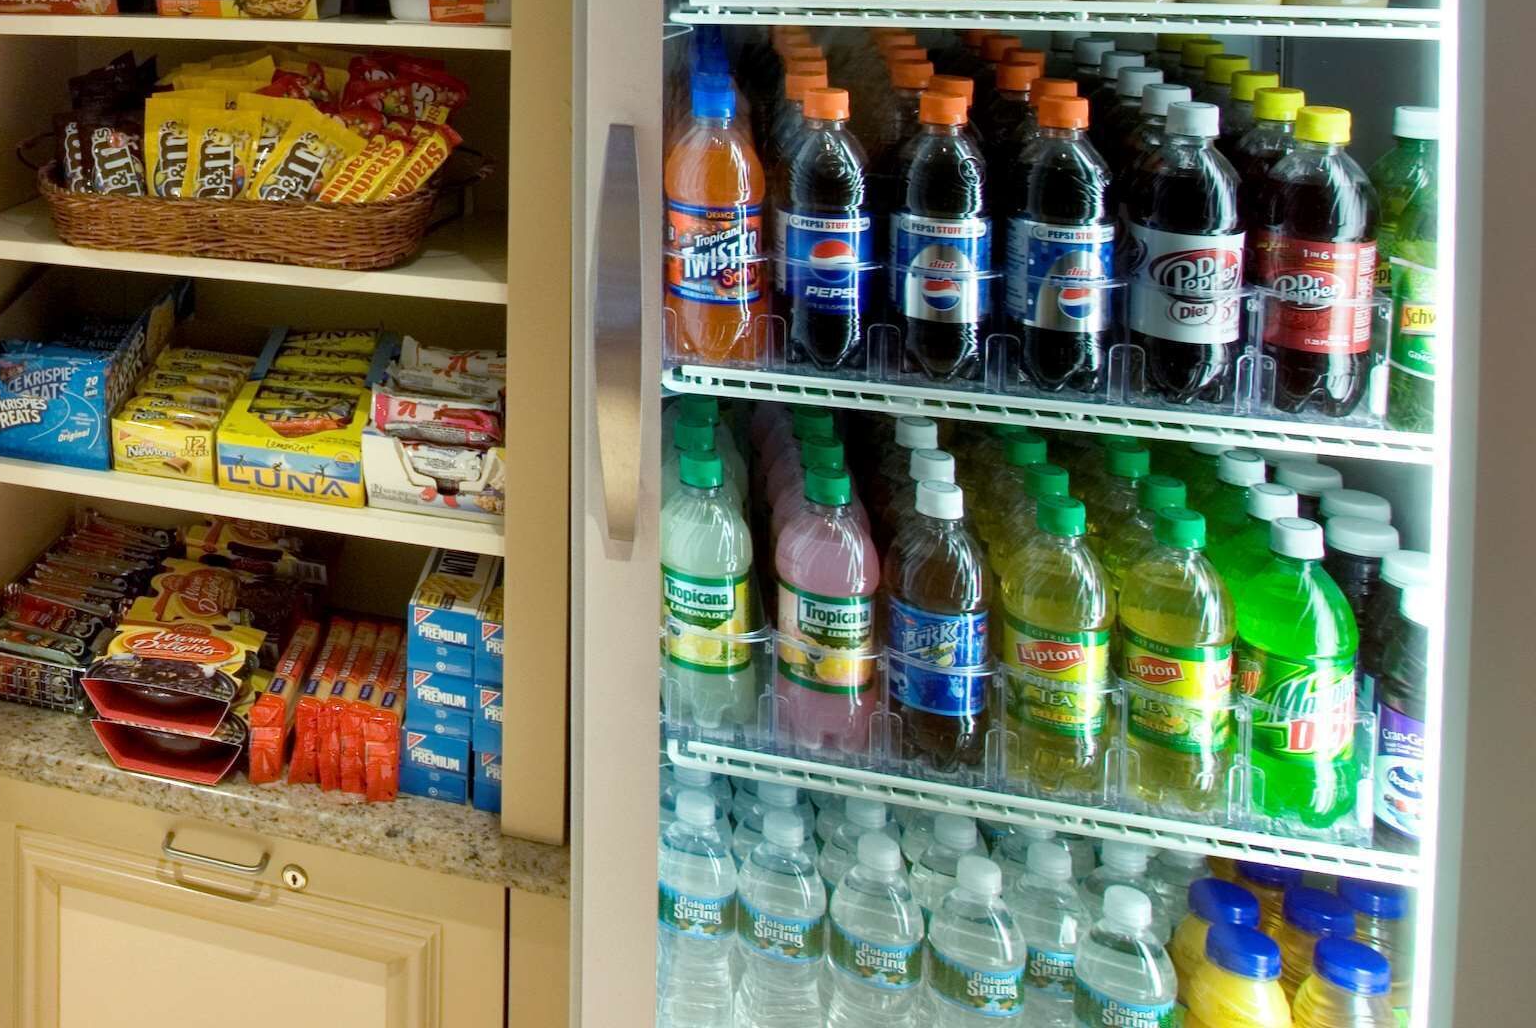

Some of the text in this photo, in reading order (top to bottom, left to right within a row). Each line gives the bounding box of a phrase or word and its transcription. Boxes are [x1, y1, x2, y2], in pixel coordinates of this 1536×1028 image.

[705, 210, 735, 221] ORANGE
[801, 219, 850, 230] PEPSI STUFF
[911, 222, 962, 236] PEPSI STUFF
[1048, 229, 1074, 241] PEPSI
[928, 258, 956, 270] diet
[1197, 255, 1226, 275] Dr
[1320, 250, 1330, 261] 6
[1164, 262, 1239, 294] Pepper
[1297, 273, 1325, 289] Dr
[1272, 275, 1340, 306] Pepper
[1179, 303, 1209, 320] Diet
[0, 395, 48, 411] KRISPIES
[57, 427, 90, 443] Original
[185, 436, 206, 450] 12
[127, 442, 176, 458] Newtons
[227, 465, 350, 499] LUNA
[665, 577, 729, 606] Tropicana
[669, 601, 729, 621] LEMONADE
[801, 600, 870, 627] Tropicana
[154, 630, 210, 645] Warm
[418, 624, 468, 646] PREMIUM
[133, 638, 218, 657] Delights
[1020, 644, 1081, 664] Lipton
[1128, 660, 1177, 677] Lipton
[417, 687, 467, 710] PREMIUM
[1038, 688, 1074, 708] TEA
[1141, 696, 1170, 717] TEA
[411, 748, 460, 773] PREMIUM
[679, 895, 718, 913] Poland
[673, 903, 722, 925] Spring
[759, 913, 800, 934] Poland
[754, 921, 804, 948] Spring
[861, 940, 904, 960] Poland
[855, 948, 908, 974] Spring
[967, 978, 1018, 999] Spring
[973, 971, 1015, 987] Poland
[1101, 1009, 1160, 1028] Spring
[1107, 1000, 1155, 1019] Poland
